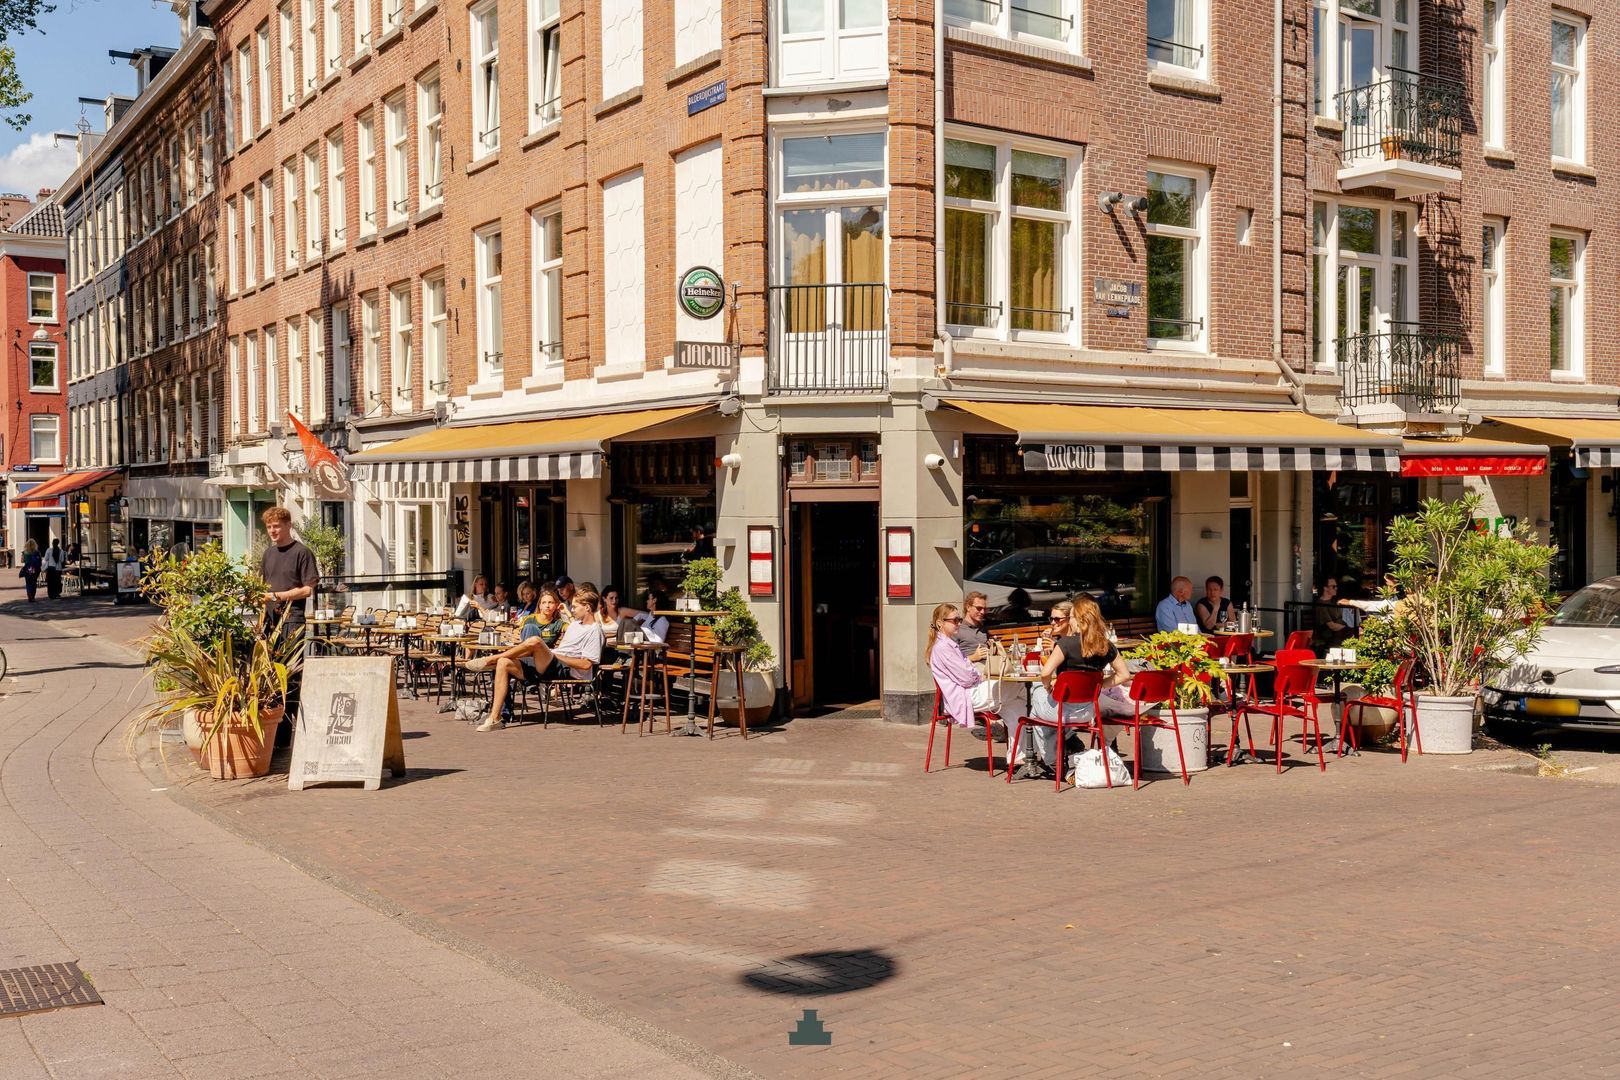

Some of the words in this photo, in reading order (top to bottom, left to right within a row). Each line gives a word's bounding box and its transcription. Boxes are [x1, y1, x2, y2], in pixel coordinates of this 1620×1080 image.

[1096, 292, 1106, 301] VAN
[1110, 283, 1128, 293] JACOB
[681, 343, 731, 367] JACOB
[1046, 445, 1095, 469] JACOB
